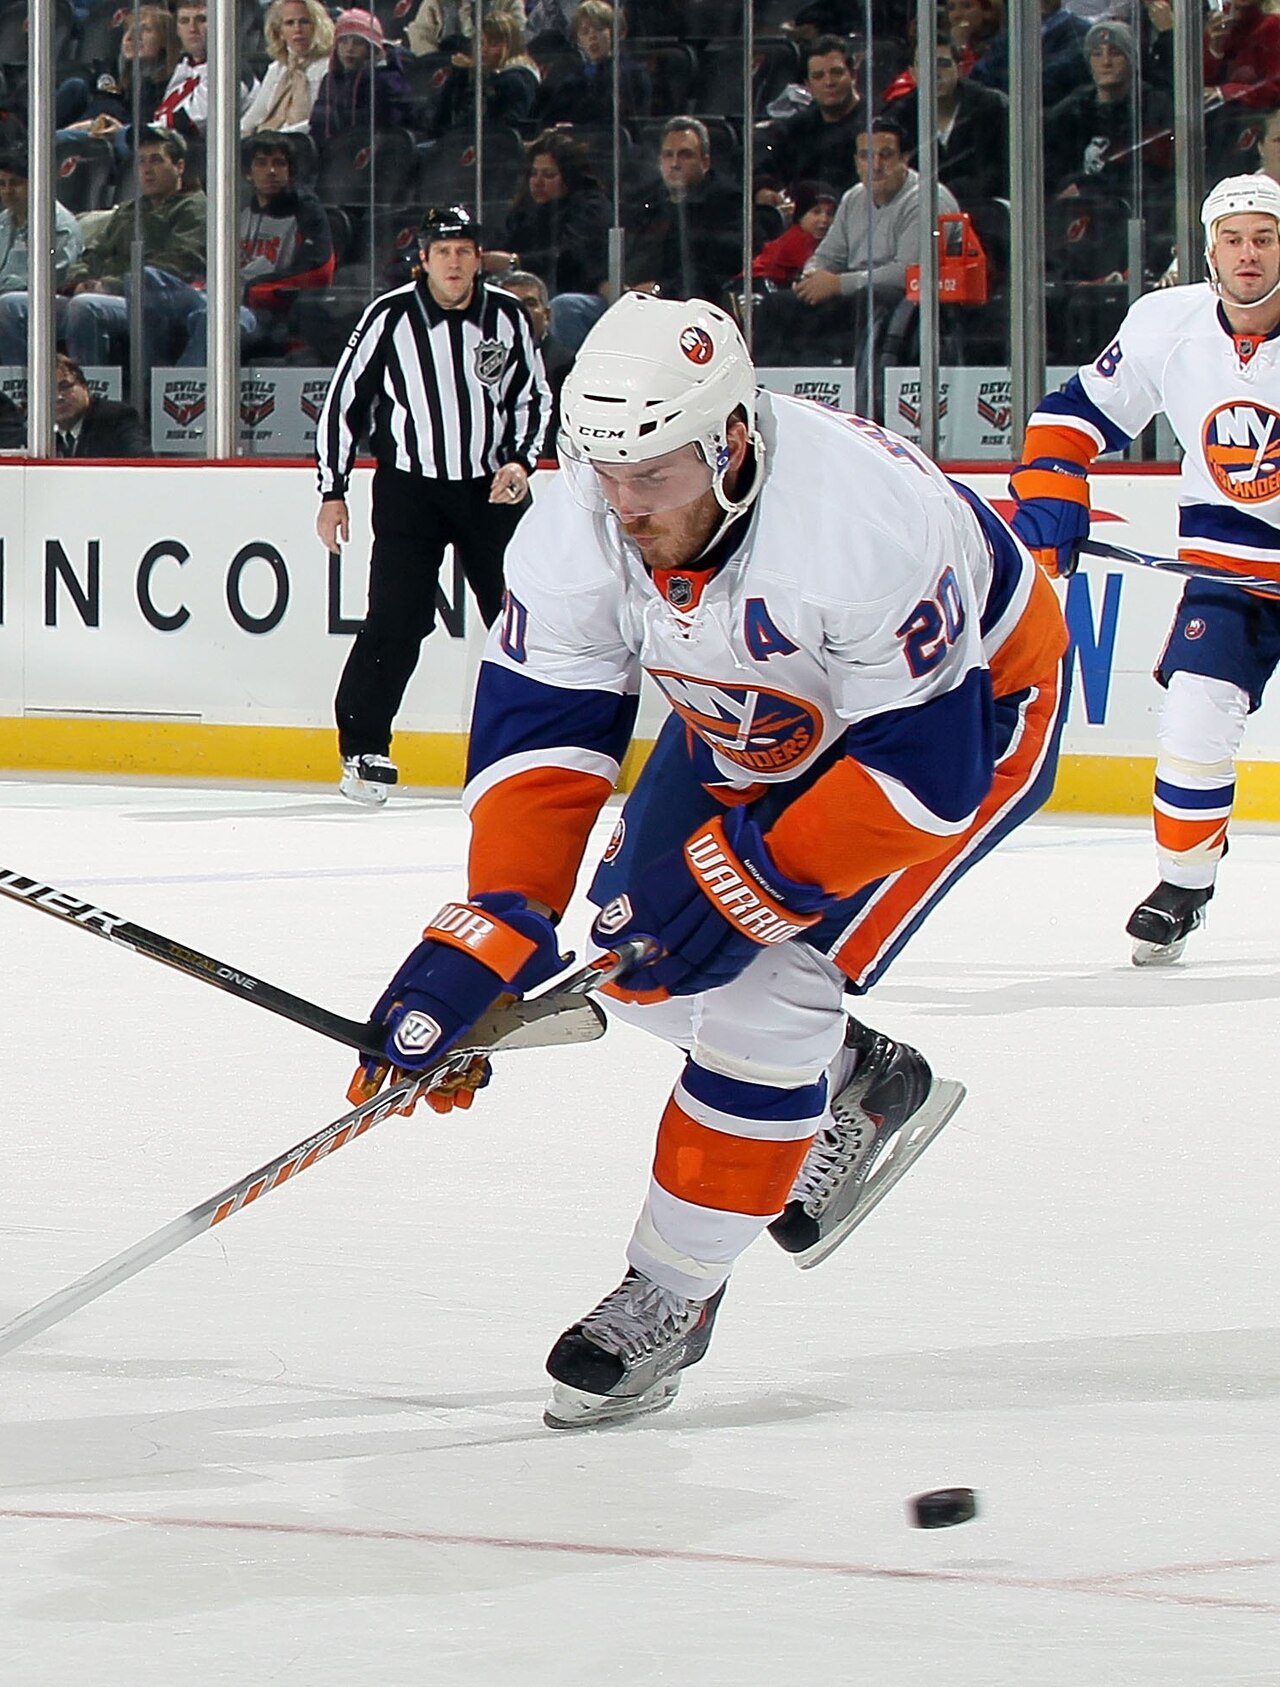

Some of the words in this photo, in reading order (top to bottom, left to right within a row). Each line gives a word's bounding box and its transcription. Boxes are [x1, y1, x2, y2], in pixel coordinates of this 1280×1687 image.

[165, 382, 207, 393] DEVILS
[240, 381, 276, 393] EVILS
[794, 382, 841, 395] DEVILS
[980, 382, 1011, 395] DEVI
[578, 425, 626, 439] CCM
[896, 565, 962, 680] 20
[744, 597, 800, 662] A
[687, 833, 808, 943] WARRIO
